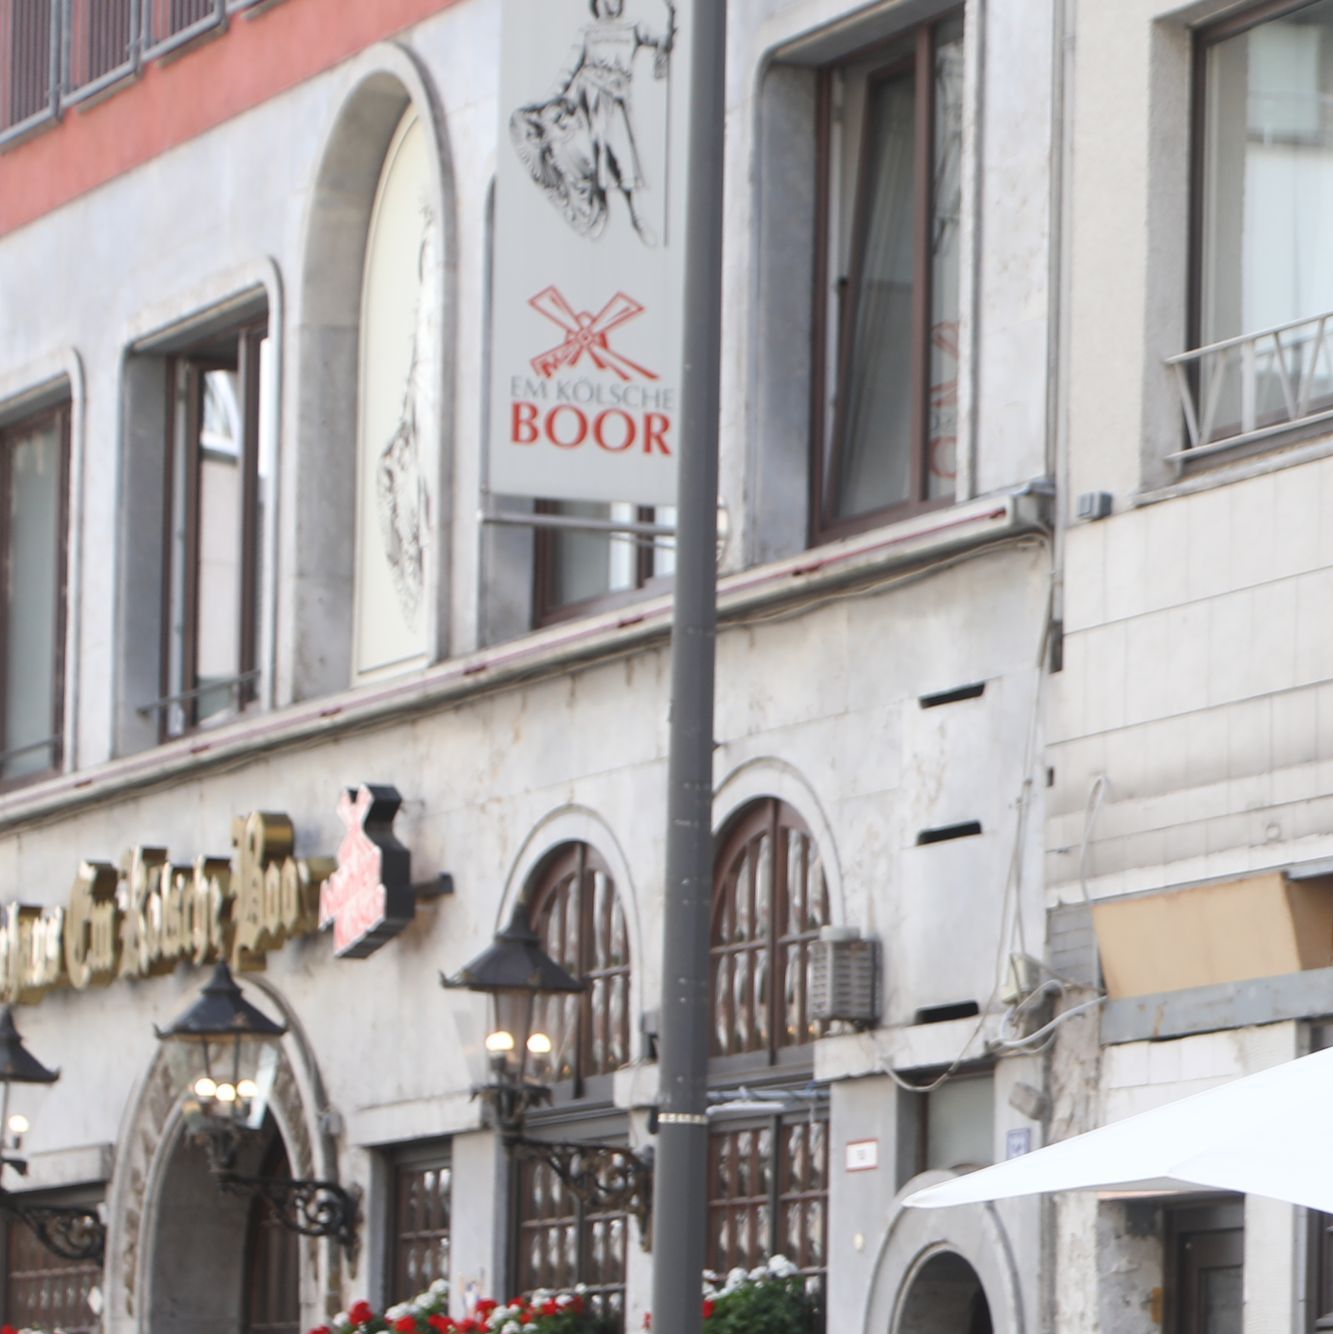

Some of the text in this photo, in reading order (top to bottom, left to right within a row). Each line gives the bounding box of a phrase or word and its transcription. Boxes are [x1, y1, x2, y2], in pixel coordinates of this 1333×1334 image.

[511, 375, 674, 411] EM KÖLSCHE
[511, 401, 673, 456] BOOR
